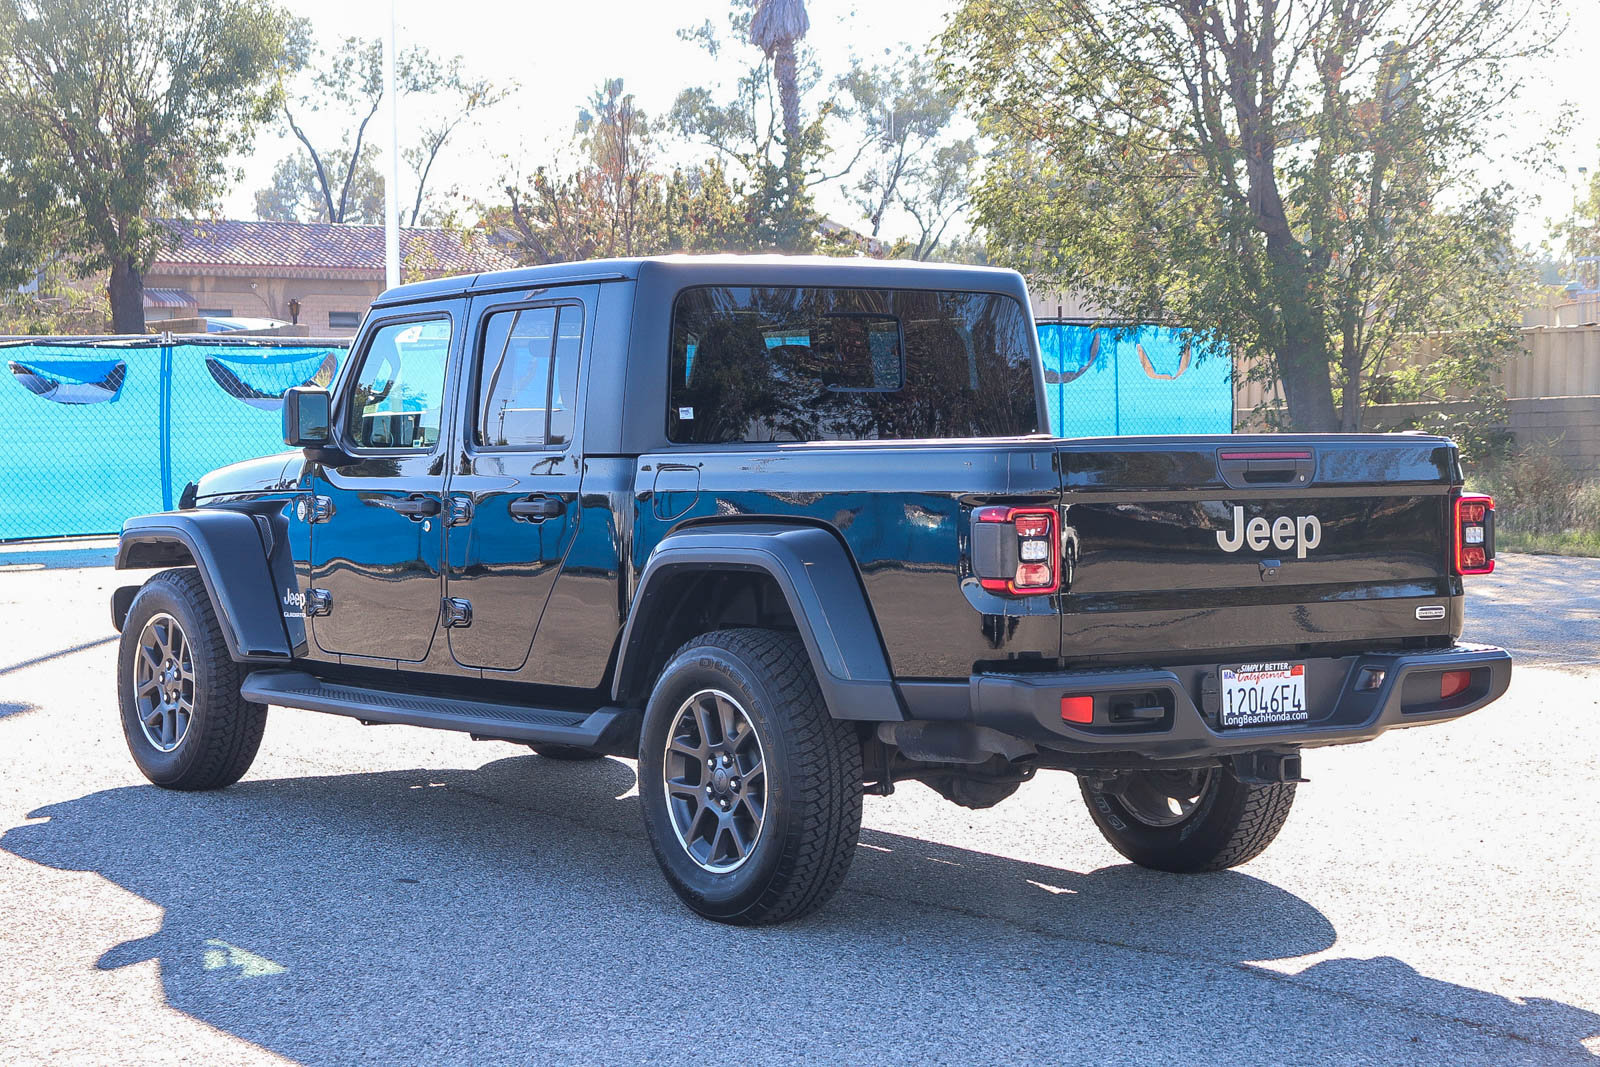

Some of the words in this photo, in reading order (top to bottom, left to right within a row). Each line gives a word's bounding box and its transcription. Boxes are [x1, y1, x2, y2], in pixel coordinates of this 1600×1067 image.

[1216, 505, 1322, 558] Jeep
[283, 587, 306, 609] Jeep
[1241, 664, 1264, 672] SIMPLY
[1265, 663, 1288, 671] BETTER
[1237, 671, 1291, 685] California
[1227, 684, 1301, 715] 12046F4
[1224, 712, 1308, 726] LongBeachHonda.com
